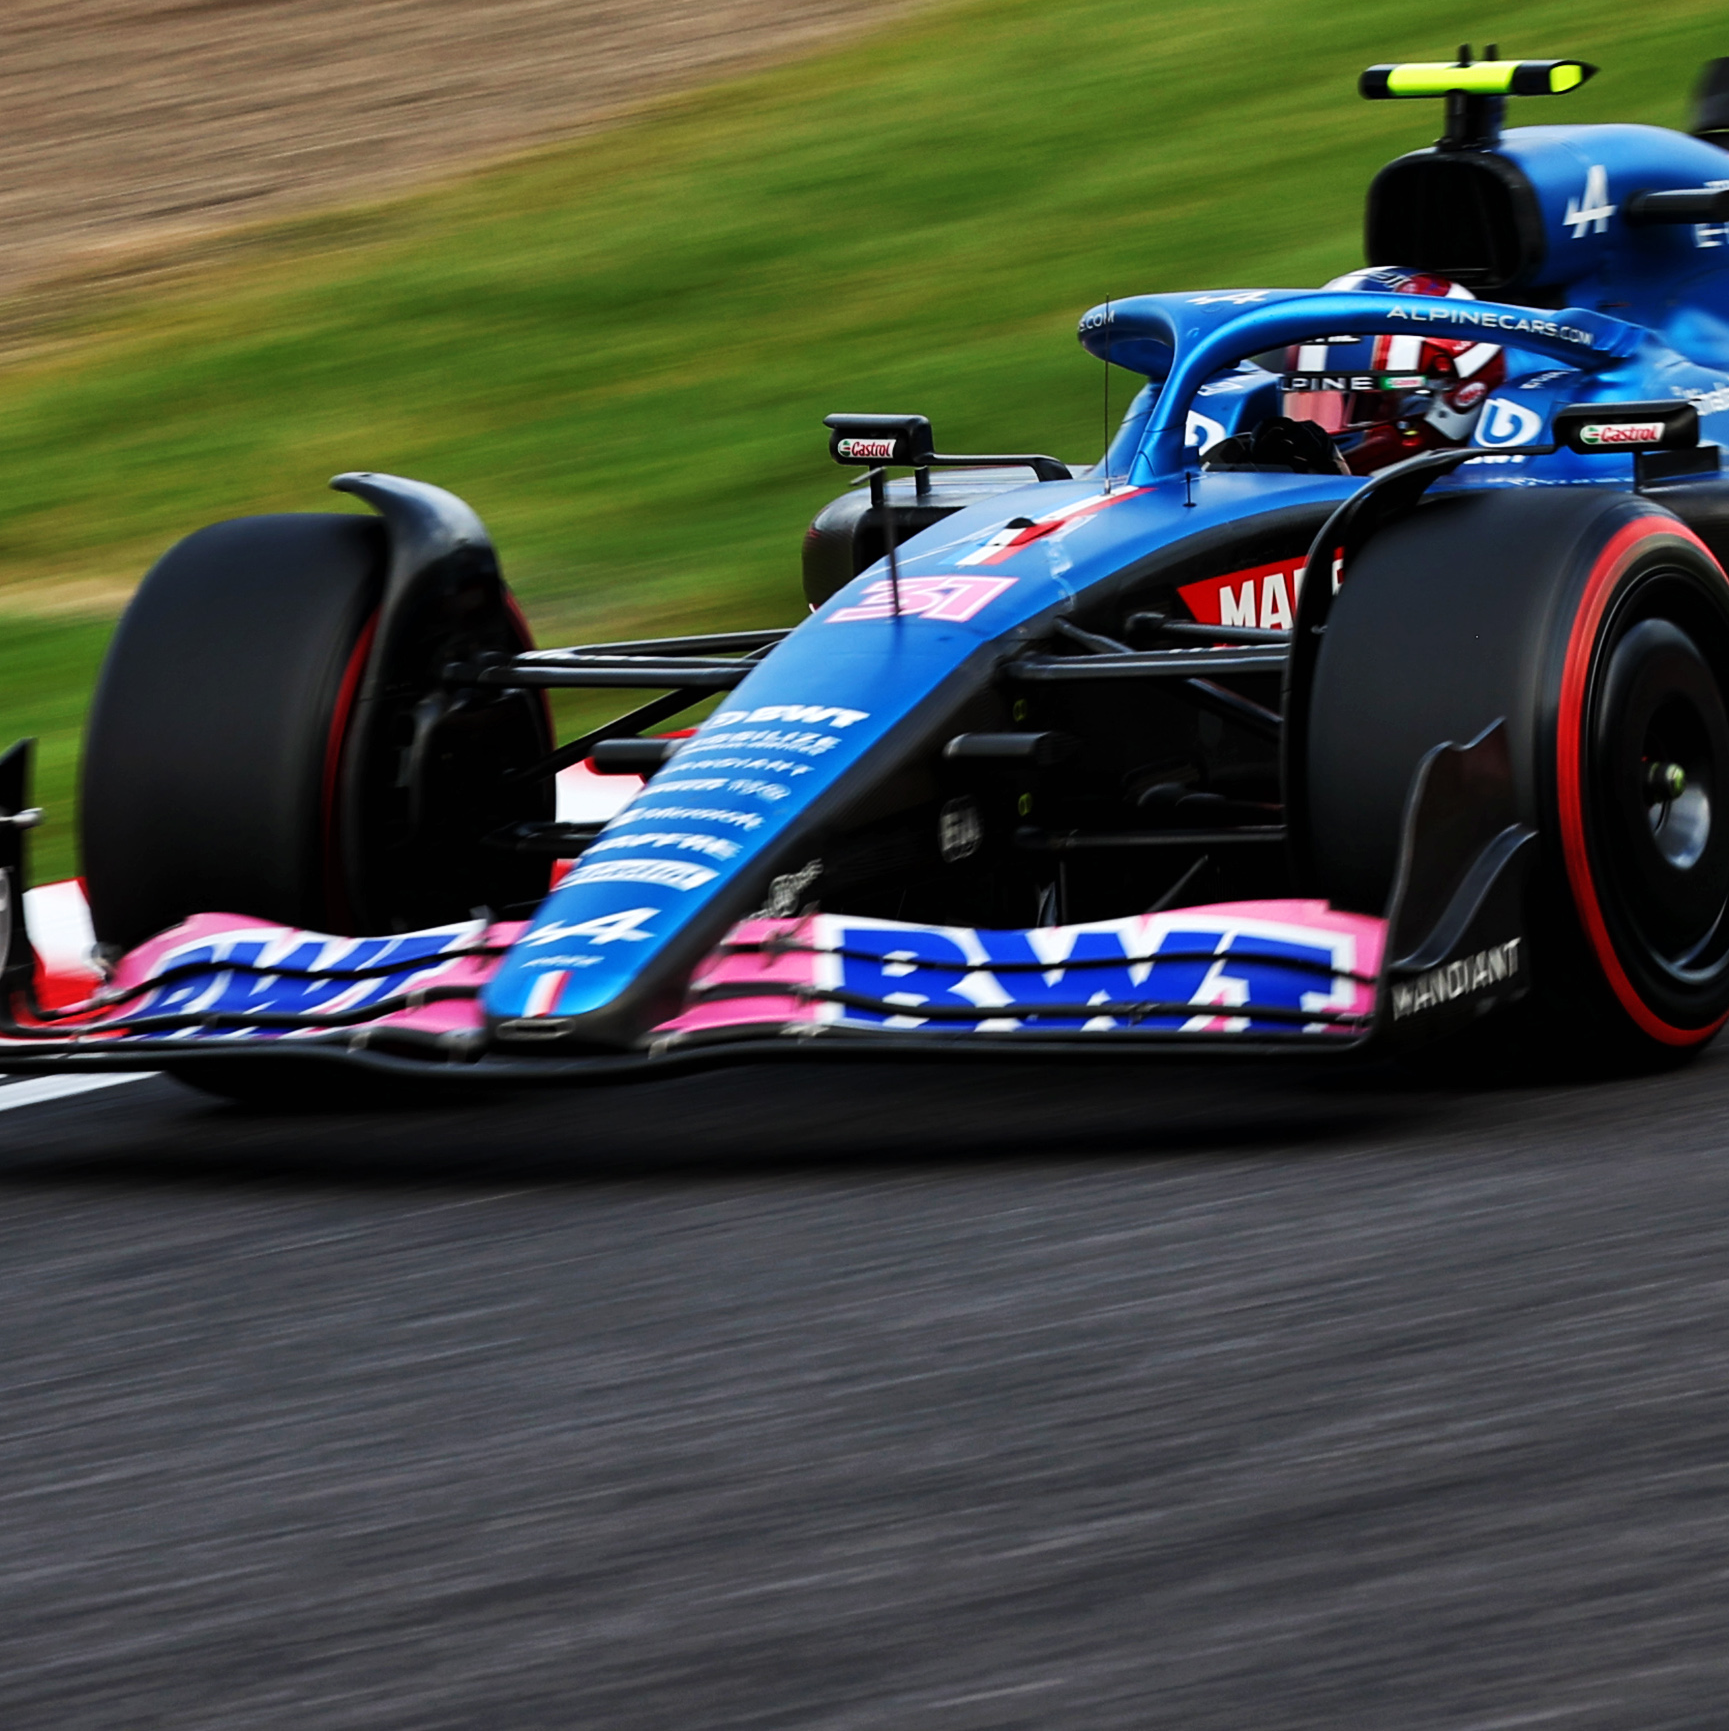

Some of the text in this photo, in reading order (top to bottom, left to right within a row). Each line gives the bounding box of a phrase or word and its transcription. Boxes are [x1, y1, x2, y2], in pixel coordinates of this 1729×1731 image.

[1386, 305, 1595, 346] ALPINECARS.COM
[1280, 376, 1373, 391] LPINE
[851, 441, 891, 457] Castrol
[1600, 425, 1658, 443] Castrol
[823, 575, 1020, 623] 31
[844, 926, 1338, 1033] BWT
[1391, 936, 1521, 1022] MANDIANT
